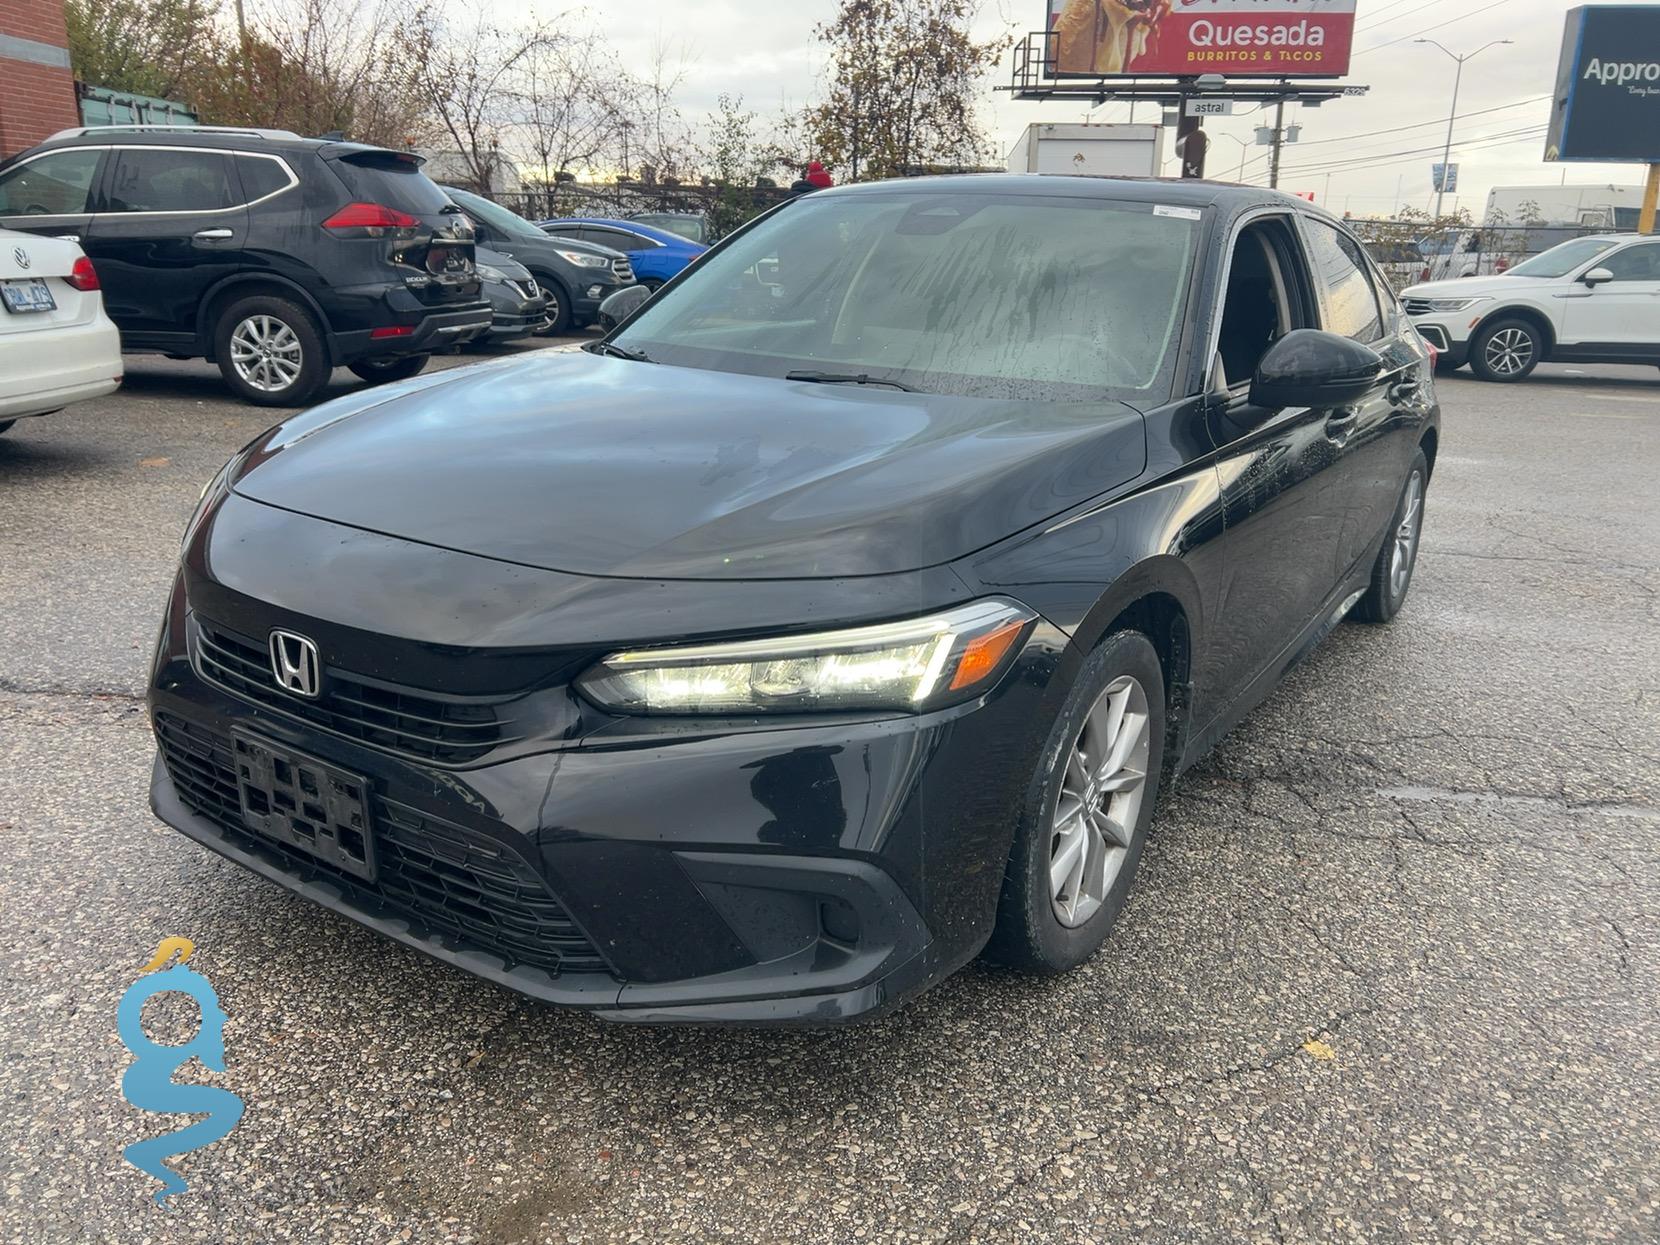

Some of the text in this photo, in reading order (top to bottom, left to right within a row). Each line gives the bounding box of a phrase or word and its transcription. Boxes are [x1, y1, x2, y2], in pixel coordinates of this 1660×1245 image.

[1188, 19, 1325, 46] Quesada
[1187, 51, 1323, 61] BURRITOS & TACOS
[1194, 102, 1225, 113] astral
